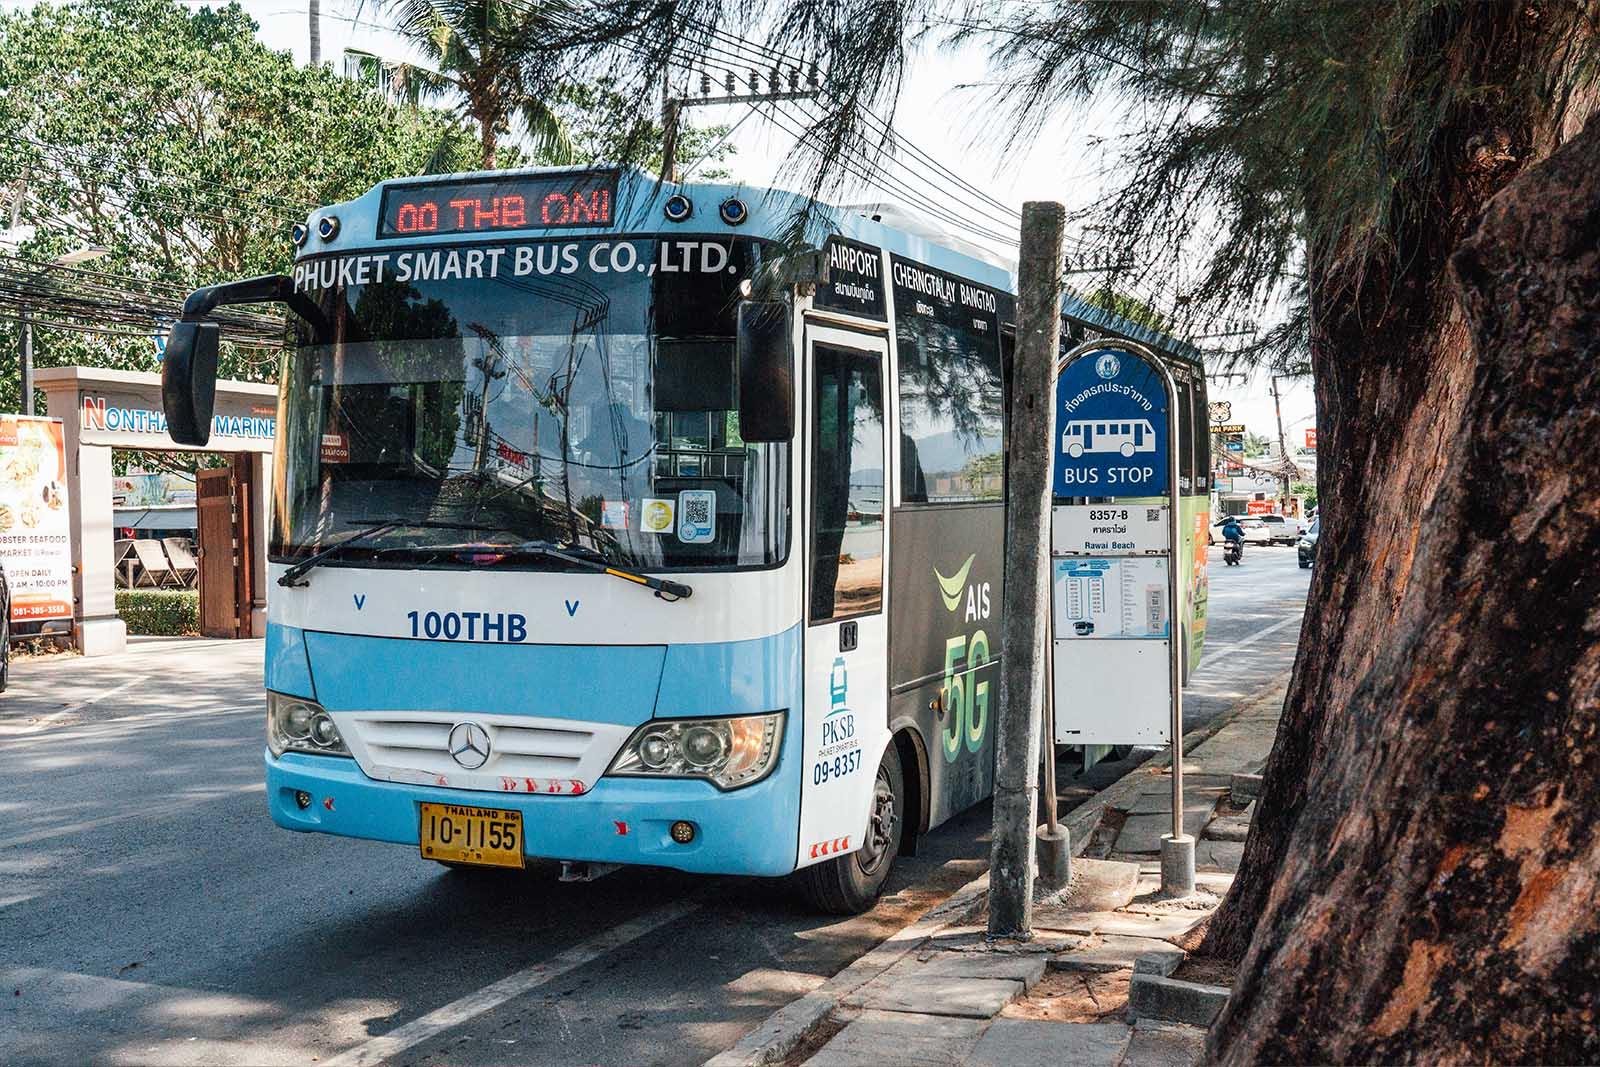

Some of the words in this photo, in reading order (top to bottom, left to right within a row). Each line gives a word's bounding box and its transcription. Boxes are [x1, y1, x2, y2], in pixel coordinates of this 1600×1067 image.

[450, 196, 527, 228] THB
[292, 255, 390, 294] PHUKET
[395, 248, 506, 282] SMART
[514, 244, 579, 276] BUS
[588, 241, 737, 277] CO.,LTD.
[830, 243, 878, 278] AIRPORT
[834, 281, 875, 304] สนามบินภูเก็ต
[893, 262, 956, 303] CHERNGTALAY
[960, 284, 996, 313] BANGTAO
[82, 396, 169, 432] NONTHA
[214, 415, 276, 438] MARINE
[1065, 468, 1099, 484] BUS
[1107, 467, 1153, 484] STOP
[1089, 510, 1129, 521] 8357-B
[29, 535, 67, 544] SEAFOOD
[1084, 541, 1109, 550] Rawai
[1111, 541, 1136, 550] Beach
[9, 569, 30, 578] OPEN
[31, 569, 52, 577] DAILY
[965, 582, 990, 624] AIS
[407, 611, 528, 642] 100THB
[942, 629, 990, 764] 5G
[822, 714, 855, 746] PKSB
[813, 749, 862, 786] 09-8357
[444, 806, 498, 819] THAILAND
[431, 815, 517, 851] 10-1155
